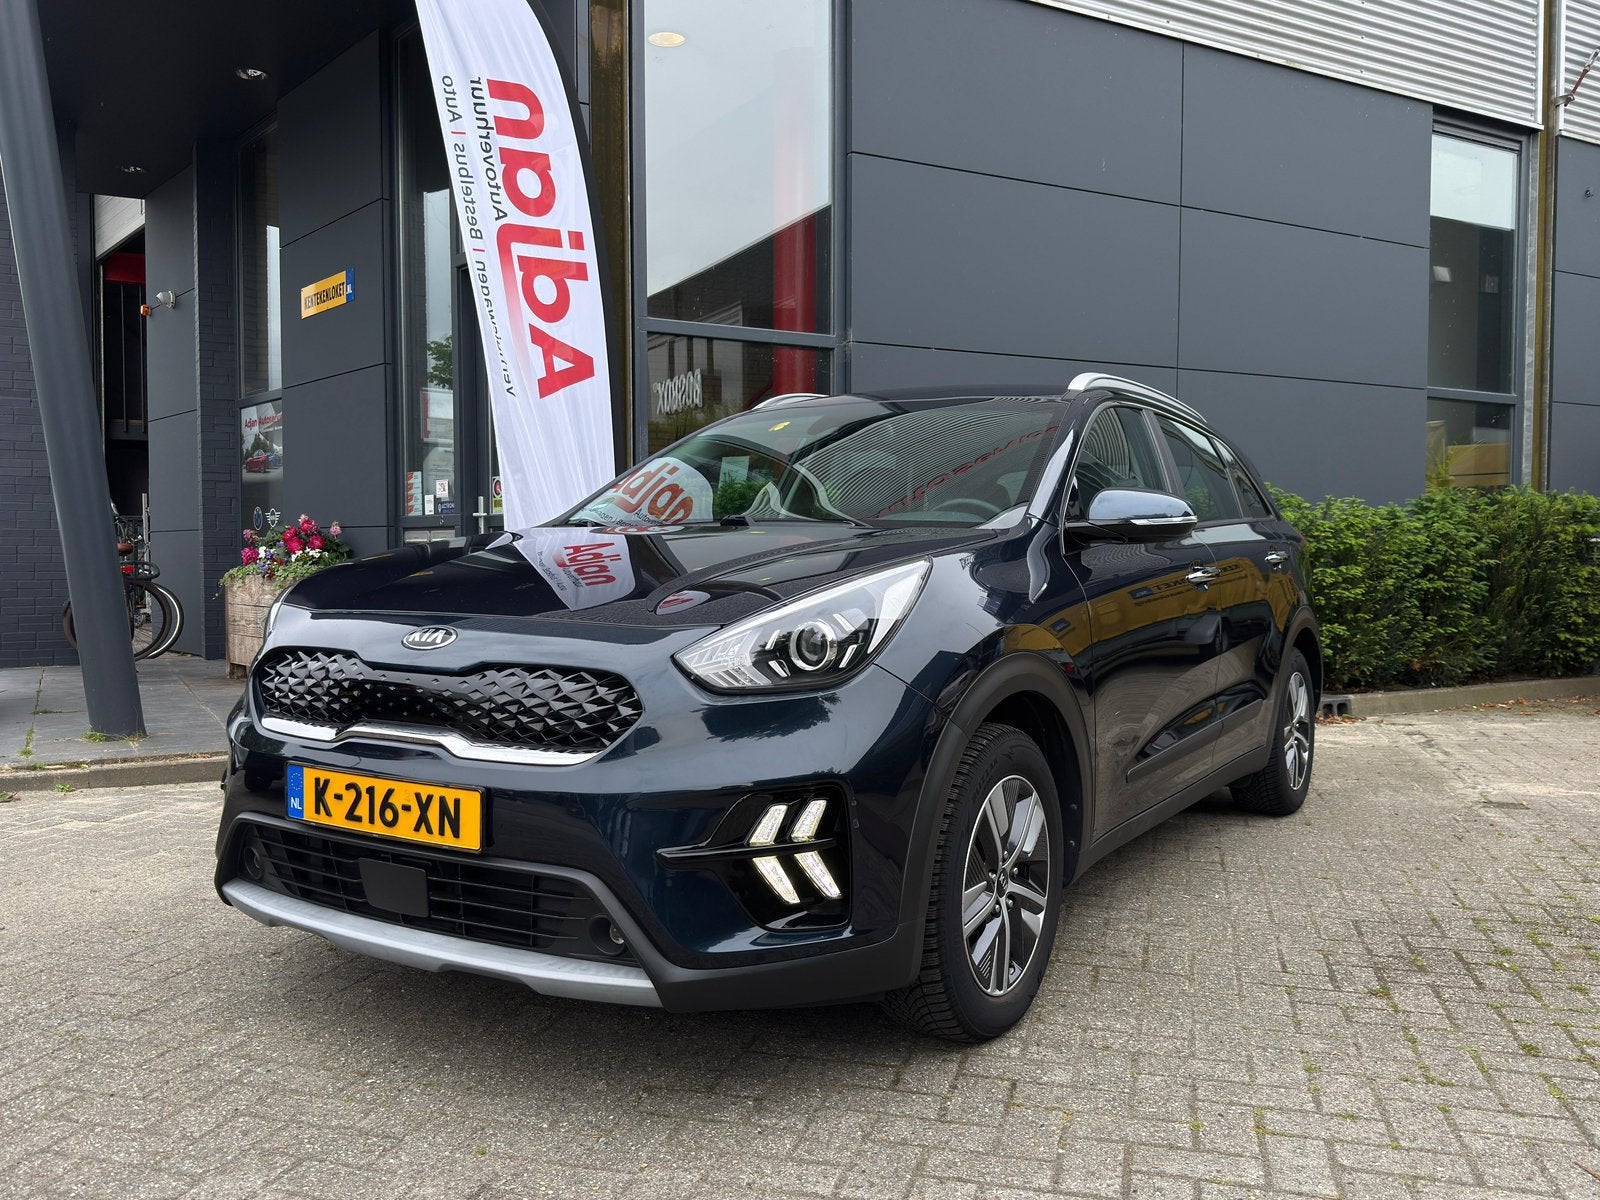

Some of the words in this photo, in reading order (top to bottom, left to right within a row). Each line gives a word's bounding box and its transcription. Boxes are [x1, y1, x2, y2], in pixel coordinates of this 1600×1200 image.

[563, 542, 622, 587] Adjan
[406, 627, 449, 645] KIA
[290, 796, 302, 810] NL
[314, 777, 460, 839] K-216-XN
